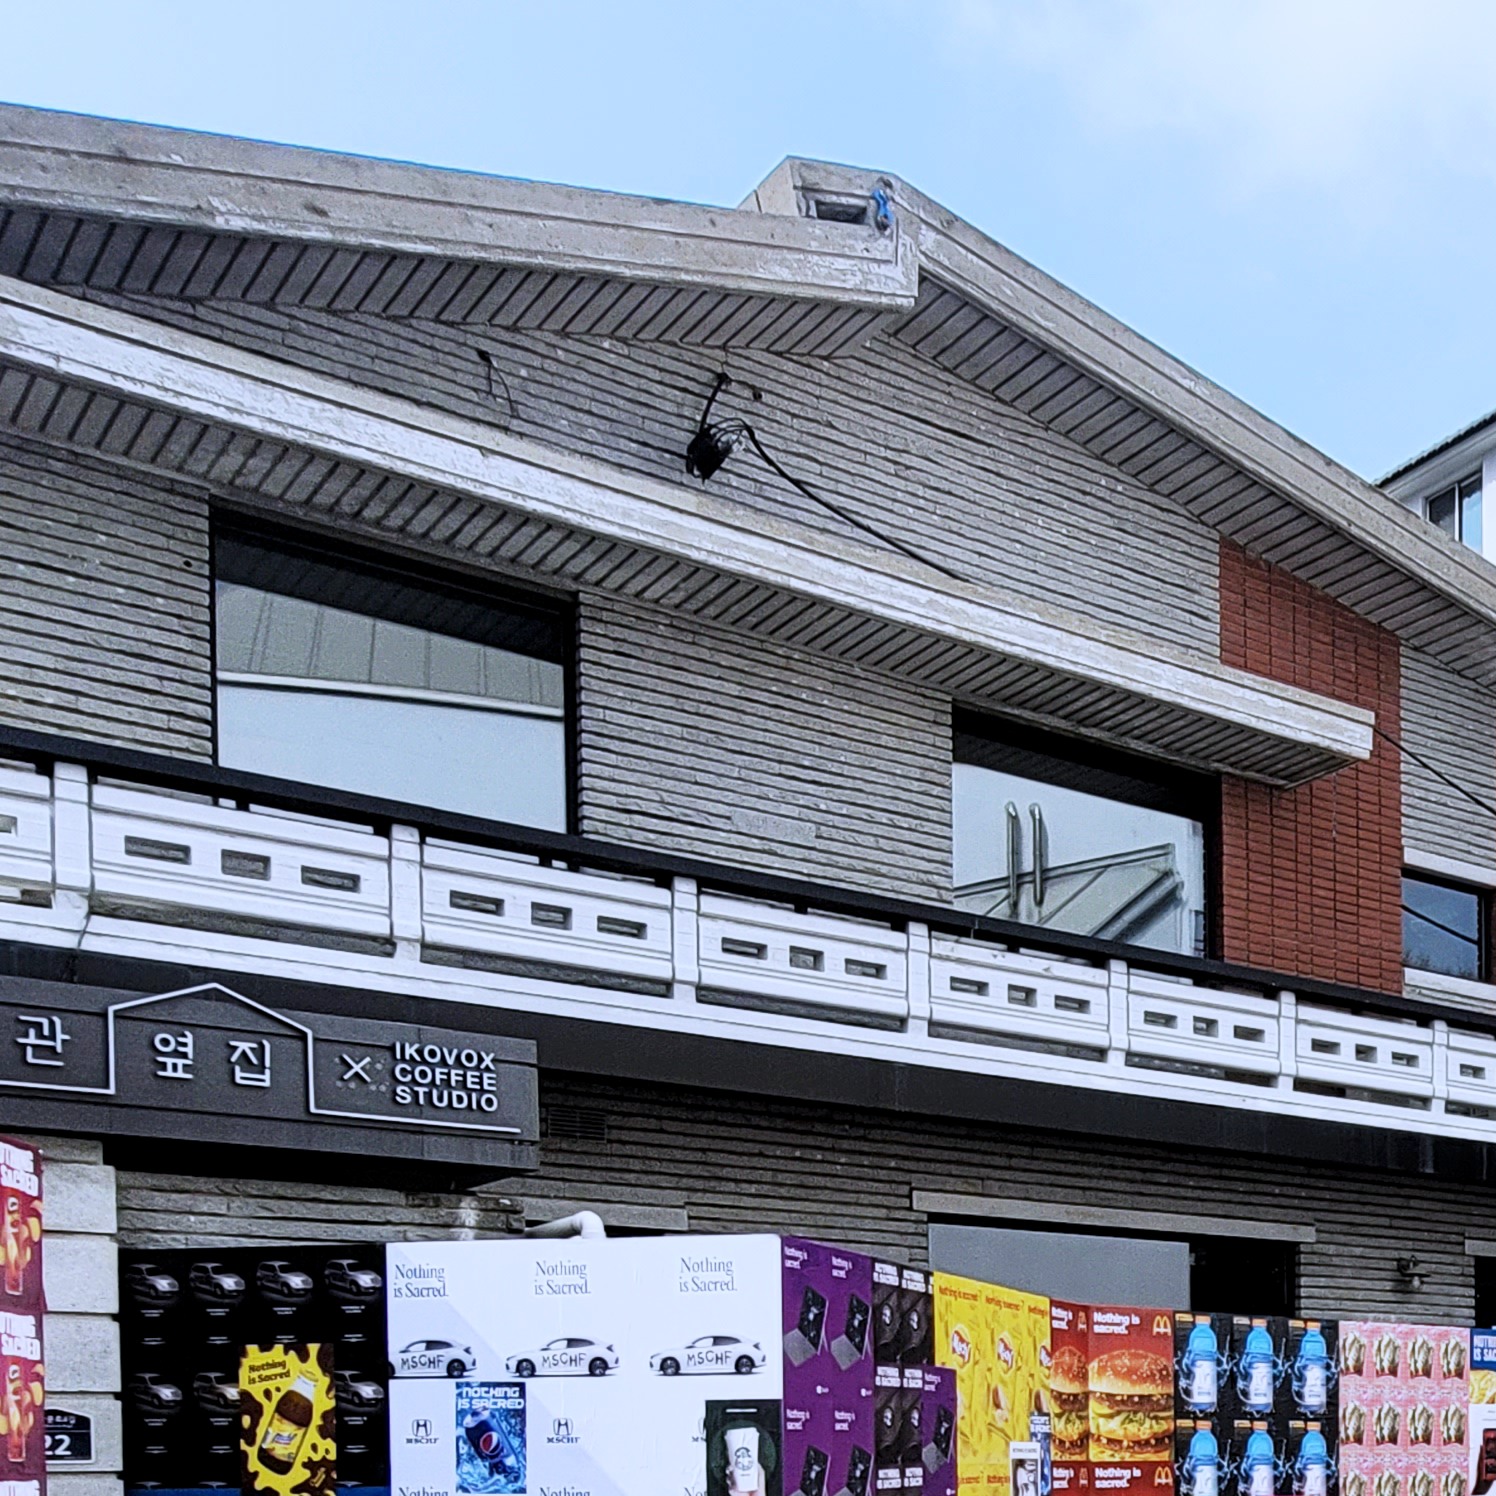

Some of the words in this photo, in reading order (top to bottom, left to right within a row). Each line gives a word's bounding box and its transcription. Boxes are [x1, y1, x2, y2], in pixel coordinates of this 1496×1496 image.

[395, 1041, 496, 1070] IKOVOX
[394, 1063, 498, 1092] COFFEE
[395, 1085, 498, 1112] STUDIO
[395, 1264, 446, 1282] Nothing
[535, 1260, 587, 1280] Nothing
[680, 1257, 734, 1276] Nothing
[393, 1283, 403, 1298] is
[534, 1280, 544, 1295] is
[679, 1278, 689, 1292] is
[1094, 1311, 1130, 1325] Nothing
[401, 1354, 445, 1371] MSCHF
[541, 1352, 586, 1368] MSCHF
[686, 1350, 732, 1366] MSCHF
[462, 1386, 519, 1398] NOTHING
[471, 1397, 524, 1410] SACRED
[1095, 1467, 1131, 1480] Nothing
